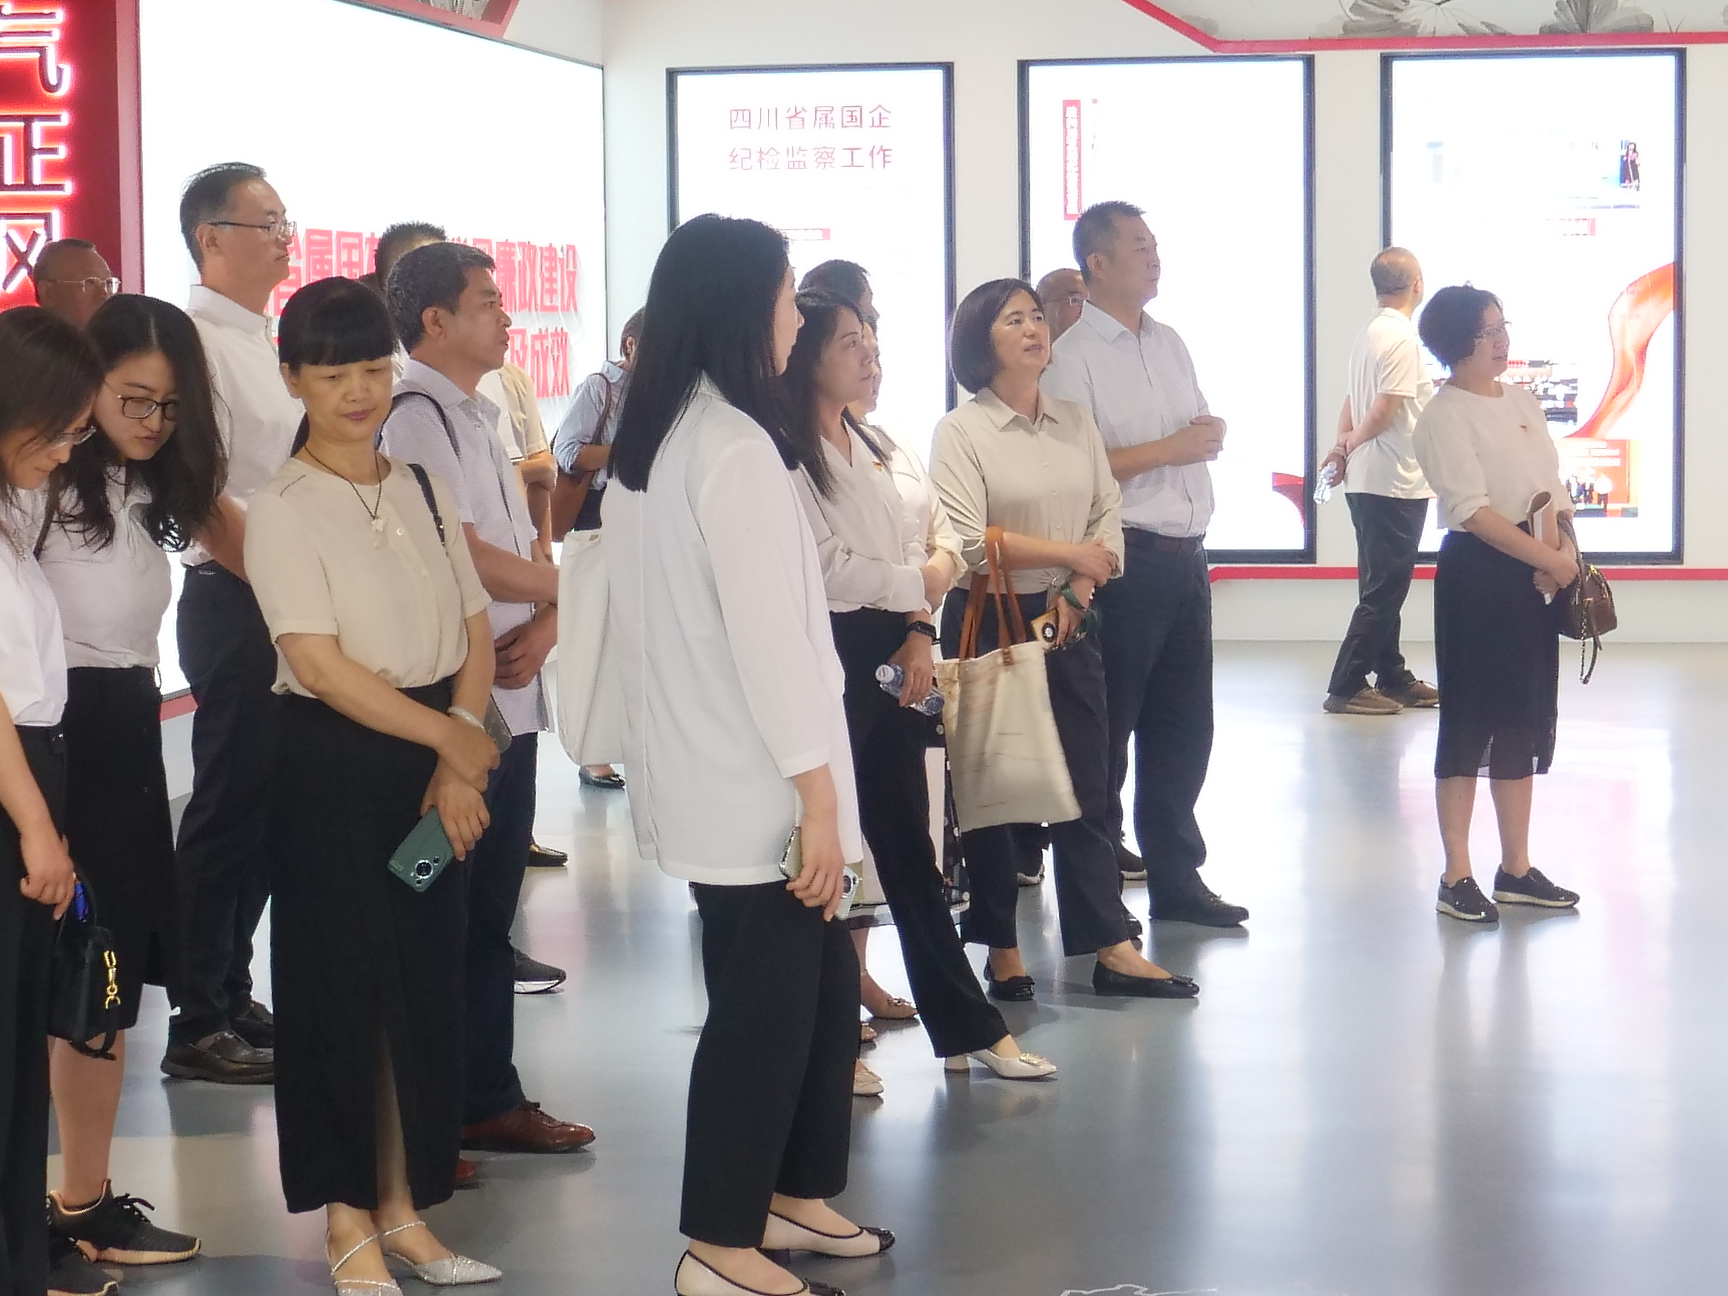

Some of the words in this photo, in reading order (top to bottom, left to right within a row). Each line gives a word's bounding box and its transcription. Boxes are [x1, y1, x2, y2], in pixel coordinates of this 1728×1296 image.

[729, 104, 891, 130] 四川省属国企
[729, 145, 892, 170] 纪检监察工作
